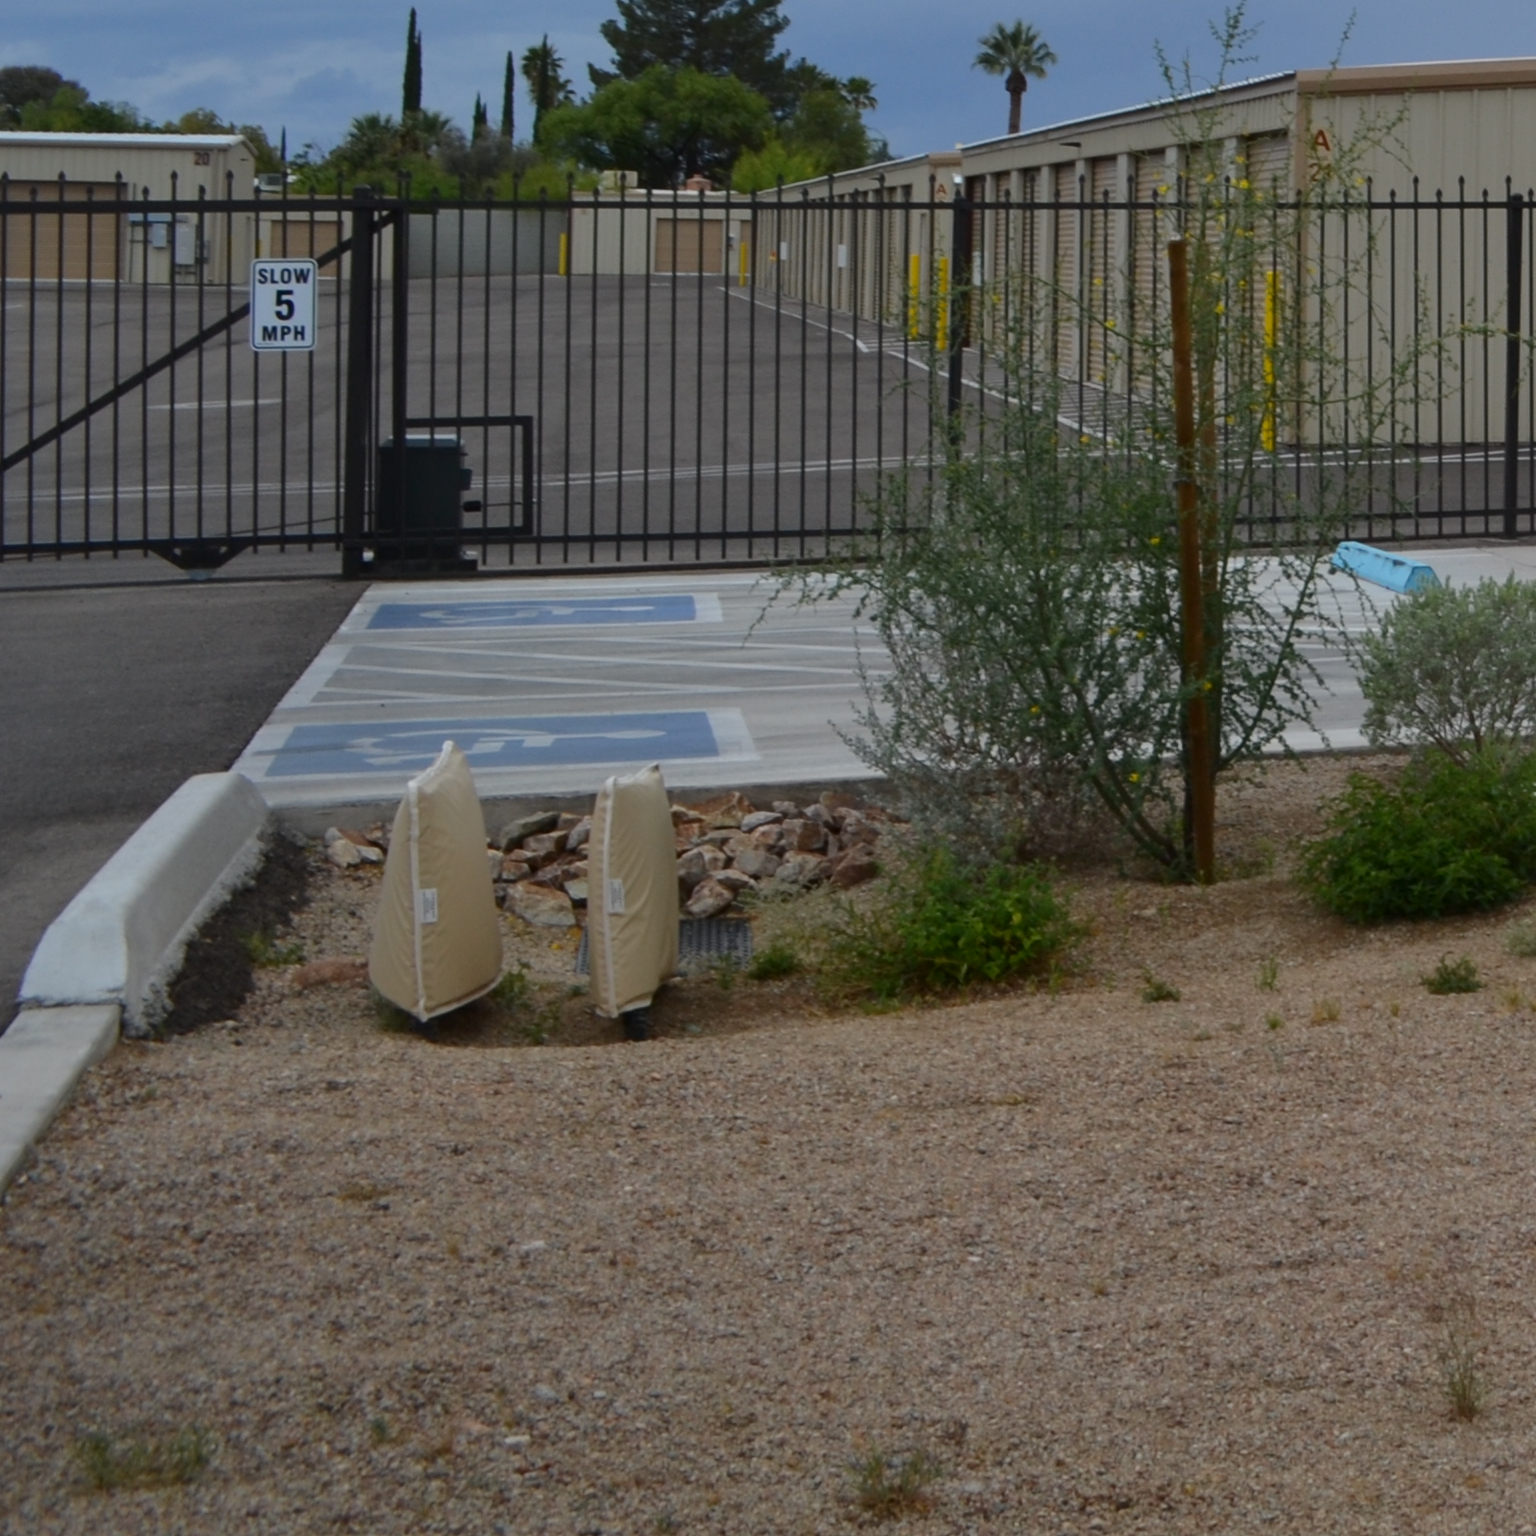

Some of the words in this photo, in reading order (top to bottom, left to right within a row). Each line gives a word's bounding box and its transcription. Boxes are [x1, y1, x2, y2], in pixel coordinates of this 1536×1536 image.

[1312, 129, 1331, 151] A
[194, 151, 211, 166] 20
[257, 267, 311, 285] SLOW
[274, 289, 296, 322] 5
[262, 325, 306, 342] MPH
